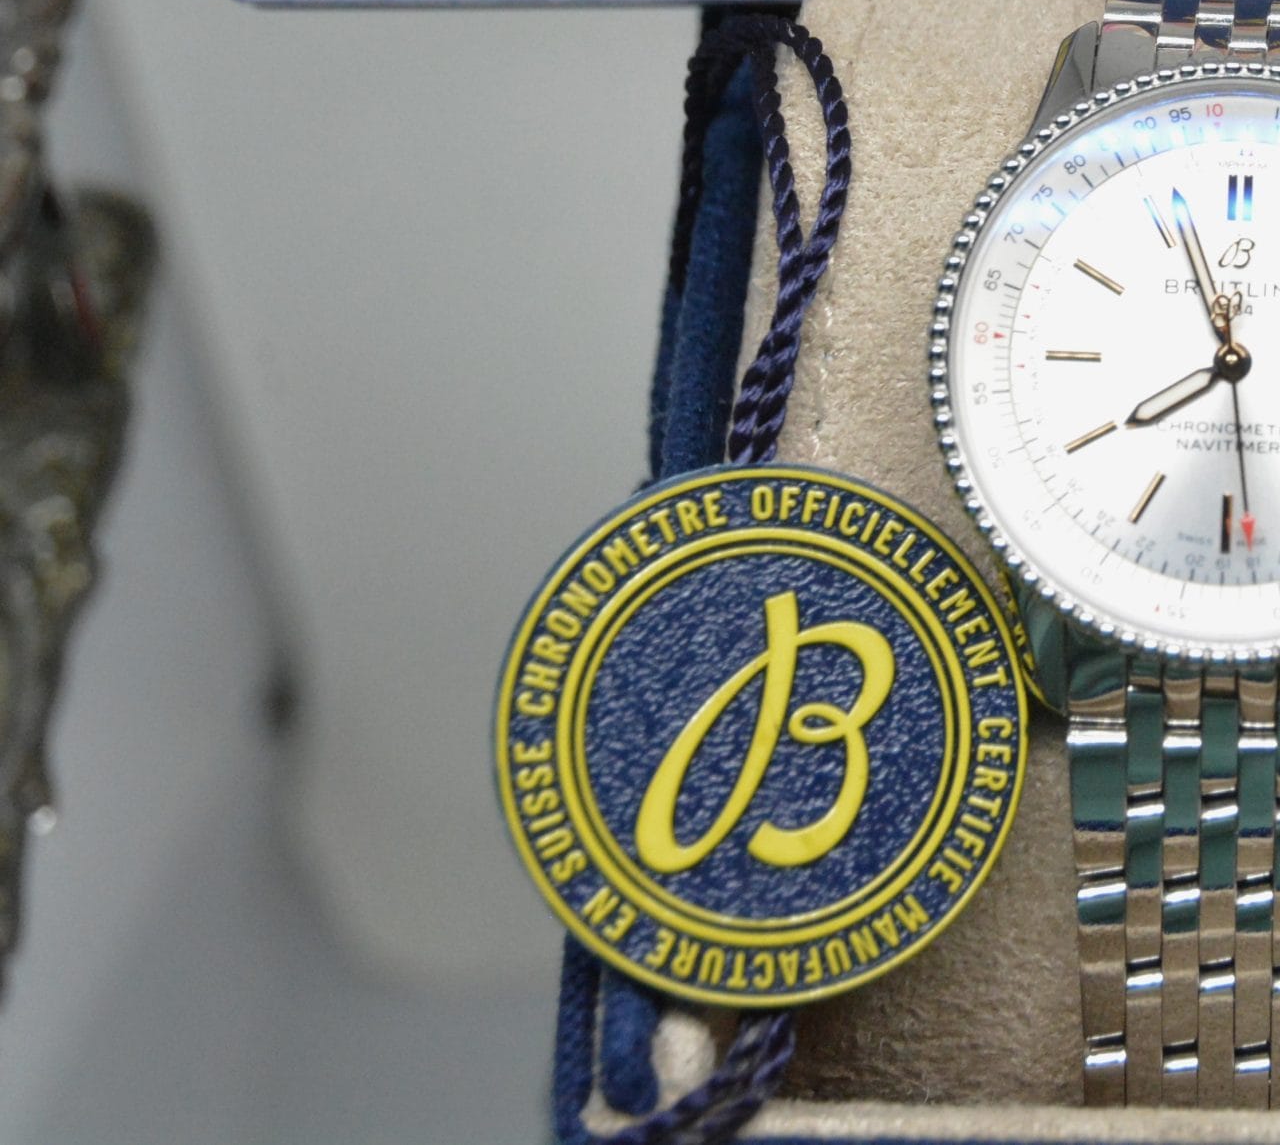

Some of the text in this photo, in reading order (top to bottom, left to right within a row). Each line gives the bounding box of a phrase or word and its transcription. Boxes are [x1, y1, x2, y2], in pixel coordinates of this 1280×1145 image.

[1168, 106, 1192, 124] 95
[1205, 103, 1224, 118] 10
[1064, 154, 1086, 175] 80
[1031, 183, 1054, 204] 75
[1004, 222, 1025, 244] 70
[983, 267, 1002, 292] 65
[973, 320, 989, 345] 60
[972, 381, 989, 406] 55
[1175, 438, 1280, 455] NAVITMER
[750, 484, 1009, 689] OFFICIELLEMENT
[516, 489, 728, 717] CHRONOMETRE
[513, 739, 589, 886] SUISSE
[928, 716, 1012, 895] CERTIFIE
[582, 886, 639, 943] EN
[647, 893, 932, 991] MANUFACTURE
